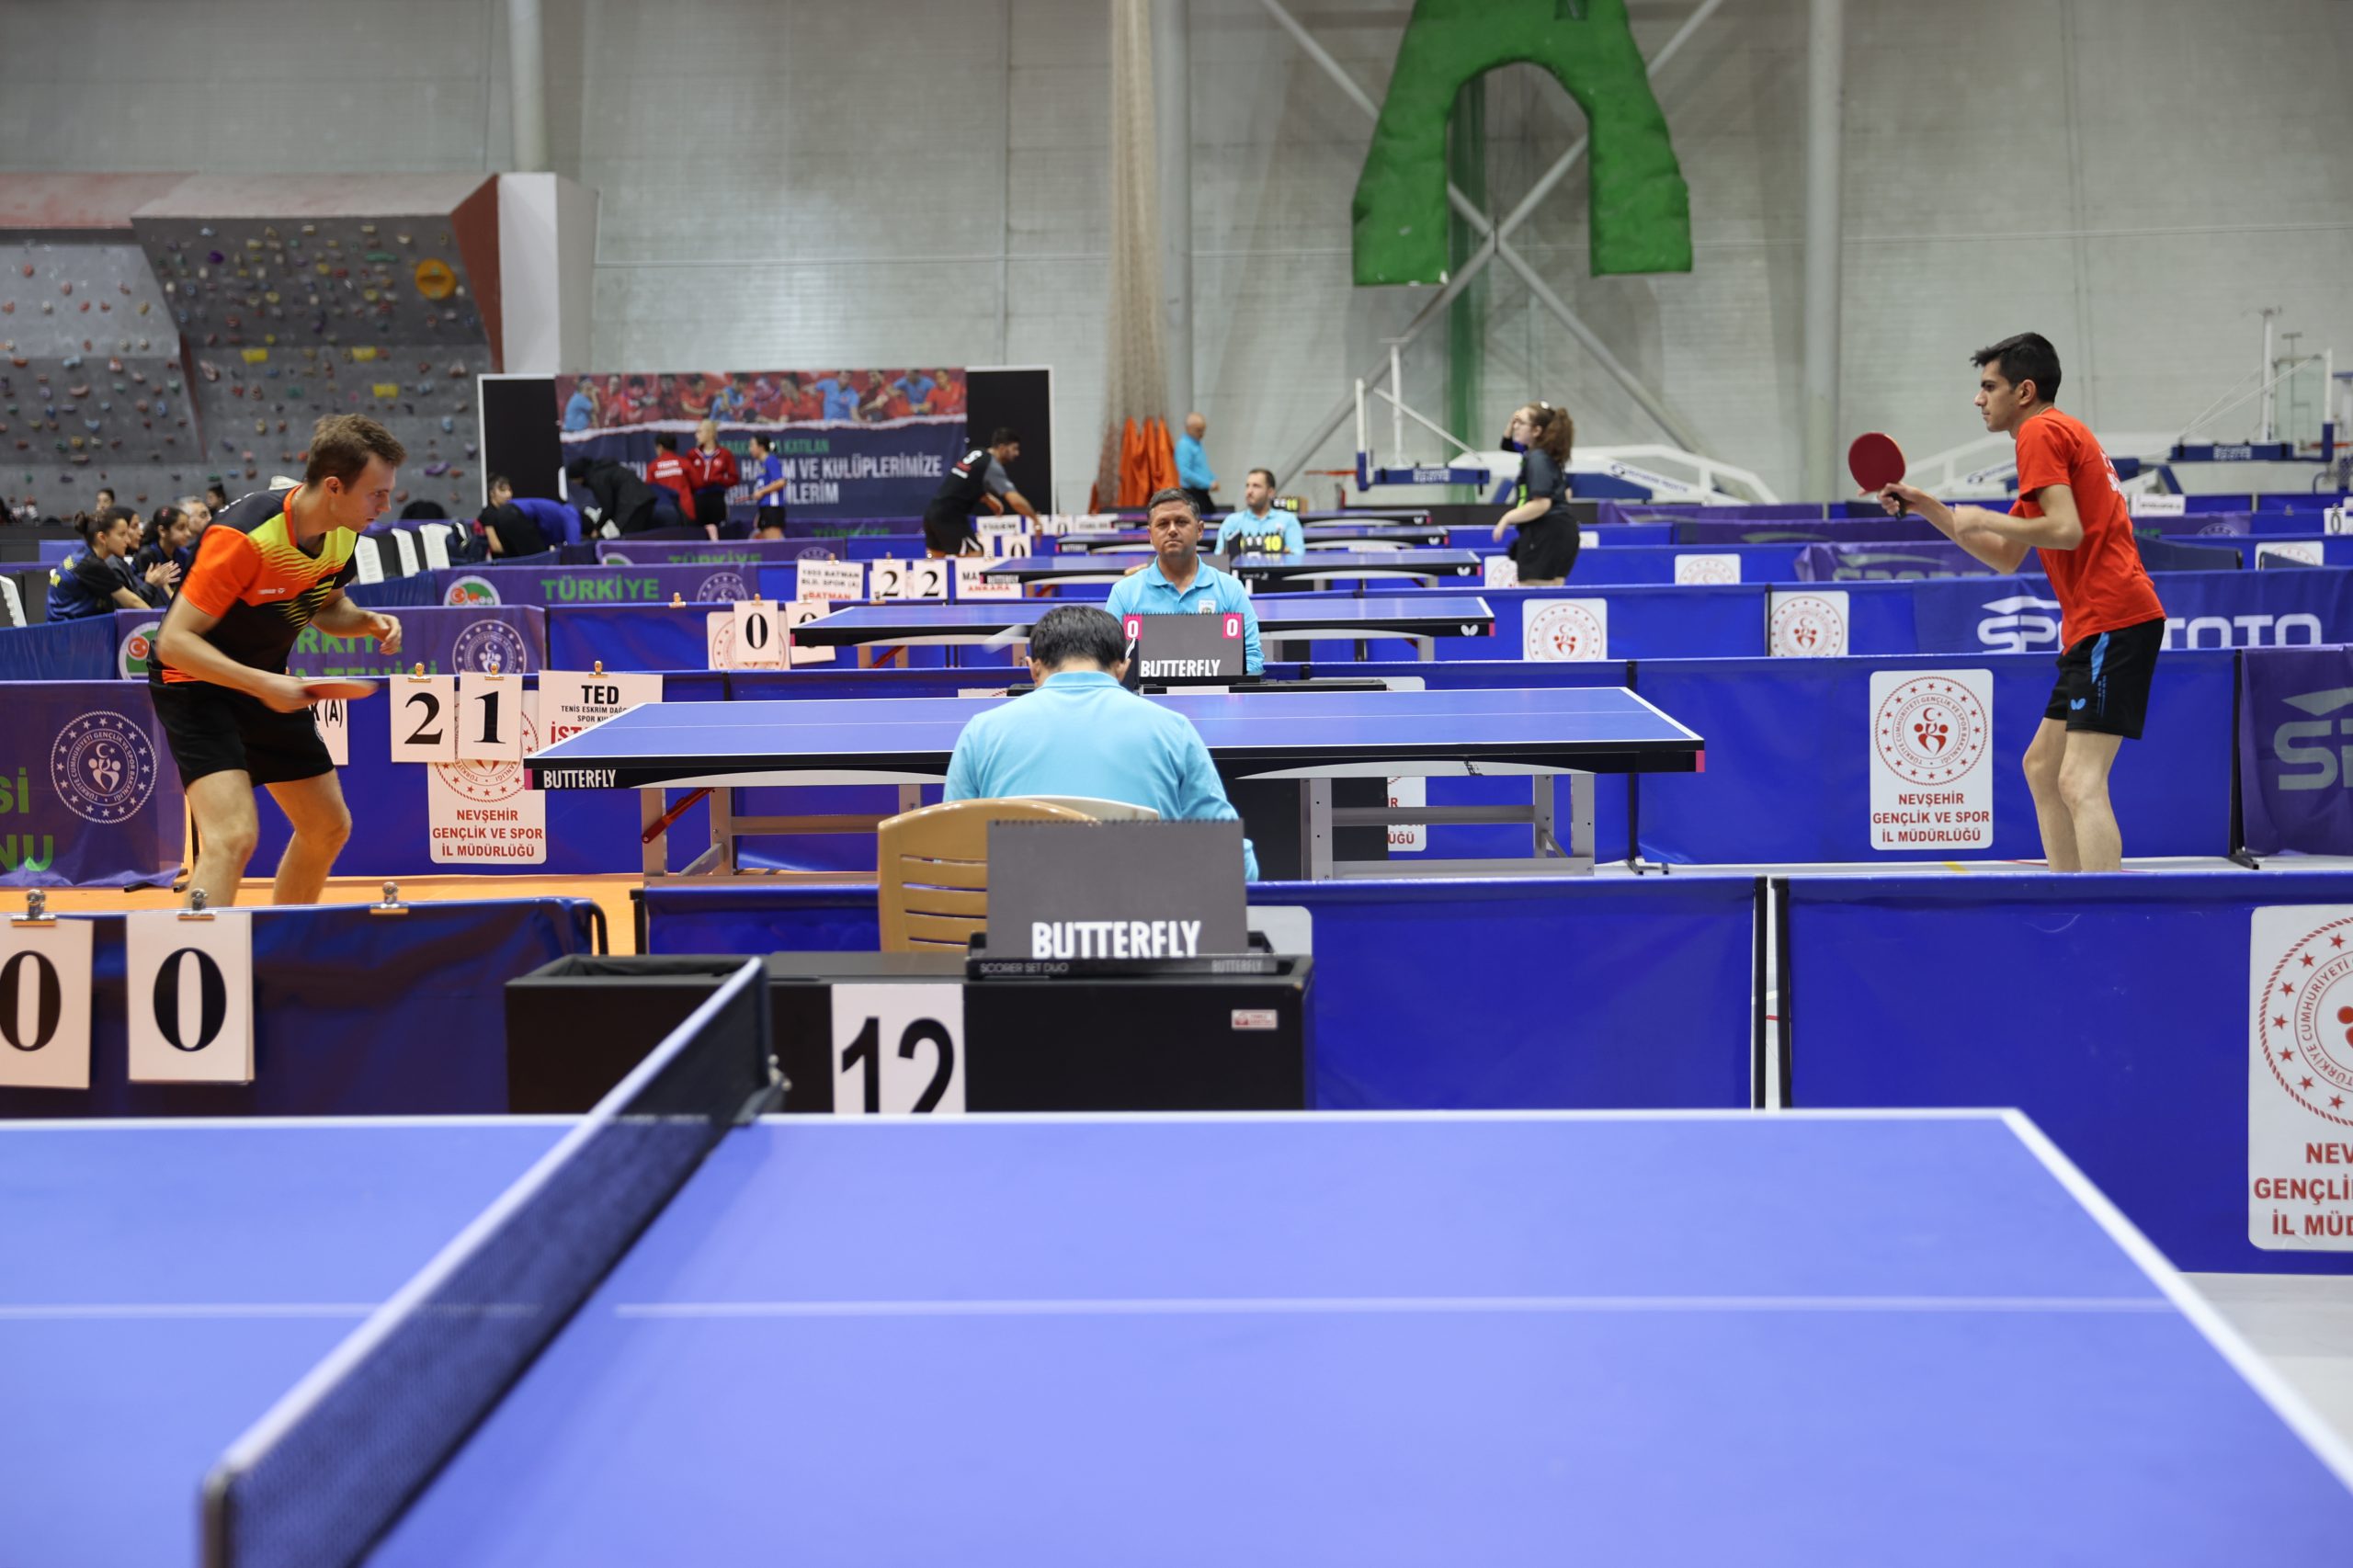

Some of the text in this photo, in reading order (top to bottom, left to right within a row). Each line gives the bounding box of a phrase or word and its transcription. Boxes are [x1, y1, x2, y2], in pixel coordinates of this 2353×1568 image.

[799, 458, 819, 479] VE
[822, 450, 943, 479] KULÜPLERİMİZE
[540, 574, 660, 602] TÜRKİYE
[881, 569, 901, 597] 2
[921, 569, 941, 597] 2
[745, 611, 769, 650] 0
[1128, 619, 1239, 638] 0 0
[1140, 658, 1221, 678] BUTTERFLY
[581, 685, 620, 704] TED
[1920, 697, 1951, 708] GENÇLİK
[404, 692, 443, 744] 2
[473, 690, 506, 744] 1
[561, 704, 580, 713] TENİS
[582, 704, 608, 713] ESKRİM
[543, 769, 617, 789] BUTTERFLY
[1898, 790, 1964, 807] NEVŞEHİR
[457, 807, 518, 823] NEVŞEHİR
[1872, 810, 1989, 826] GENÇLİK VE SPOR
[432, 825, 542, 842] GENÇLİK VE SPOR
[1881, 826, 1981, 842] İL MÜDÜRLÜĞÜ
[442, 843, 535, 857] İL MÜDÜRLÜĞÜ
[1031, 921, 1201, 959] BUTTERFLY
[1025, 962, 1042, 974] SET
[1211, 960, 1264, 973] BUTTERFLY
[0, 949, 62, 1052] 0
[153, 947, 227, 1052] 0
[2301, 958, 2350, 1042] CUMHURİYETİ
[840, 1016, 956, 1114] 12
[2253, 1174, 2353, 1205] GENÇLİ
[2272, 1209, 2295, 1235] İL
